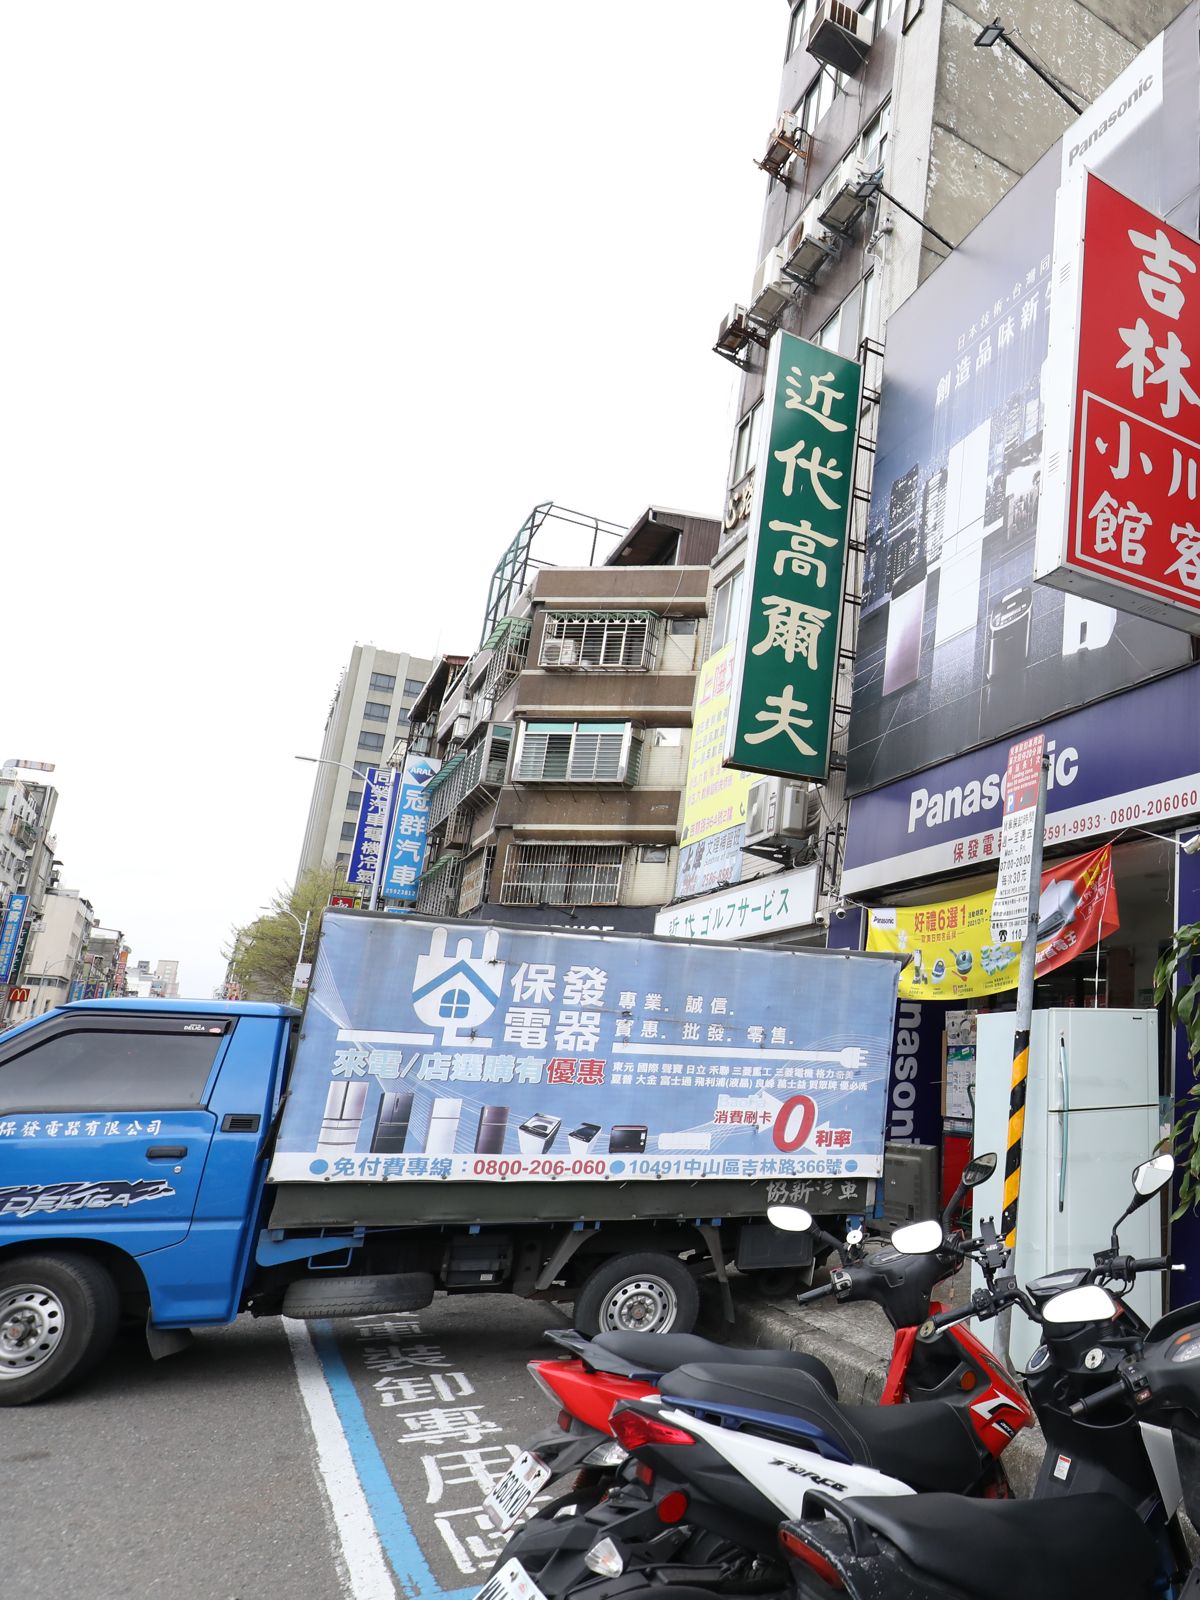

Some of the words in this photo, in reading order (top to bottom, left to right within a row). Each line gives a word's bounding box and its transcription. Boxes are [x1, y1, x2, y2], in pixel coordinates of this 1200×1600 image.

[1068, 73, 1154, 167] Panasonic
[1088, 421, 1153, 566] 小館
[744, 366, 848, 756] 近代高爾夫
[410, 766, 433, 776] ARAL
[908, 740, 1079, 833] Panasic
[1110, 789, 1198, 825] 0800-206060
[390, 789, 431, 887] 冠群汽車
[953, 832, 1002, 864] 保發電
[873, 915, 895, 925] Panasonic
[915, 904, 967, 932] 好禮6選1
[511, 962, 609, 1006] 保發
[503, 1006, 601, 1052] 電器
[635, 1075, 657, 1086] 大金
[686, 1064, 706, 1075] 日立
[0, 1119, 162, 1138] 保發電器有限公司
[714, 1110, 772, 1125] 消費刷卡
[772, 1094, 816, 1153] 0
[815, 1129, 852, 1148] 利率
[473, 1158, 606, 1176] 0800-206-060
[629, 1158, 842, 1176] 10491中山區吉林路366號
[2, 1193, 131, 1213] DELICA
